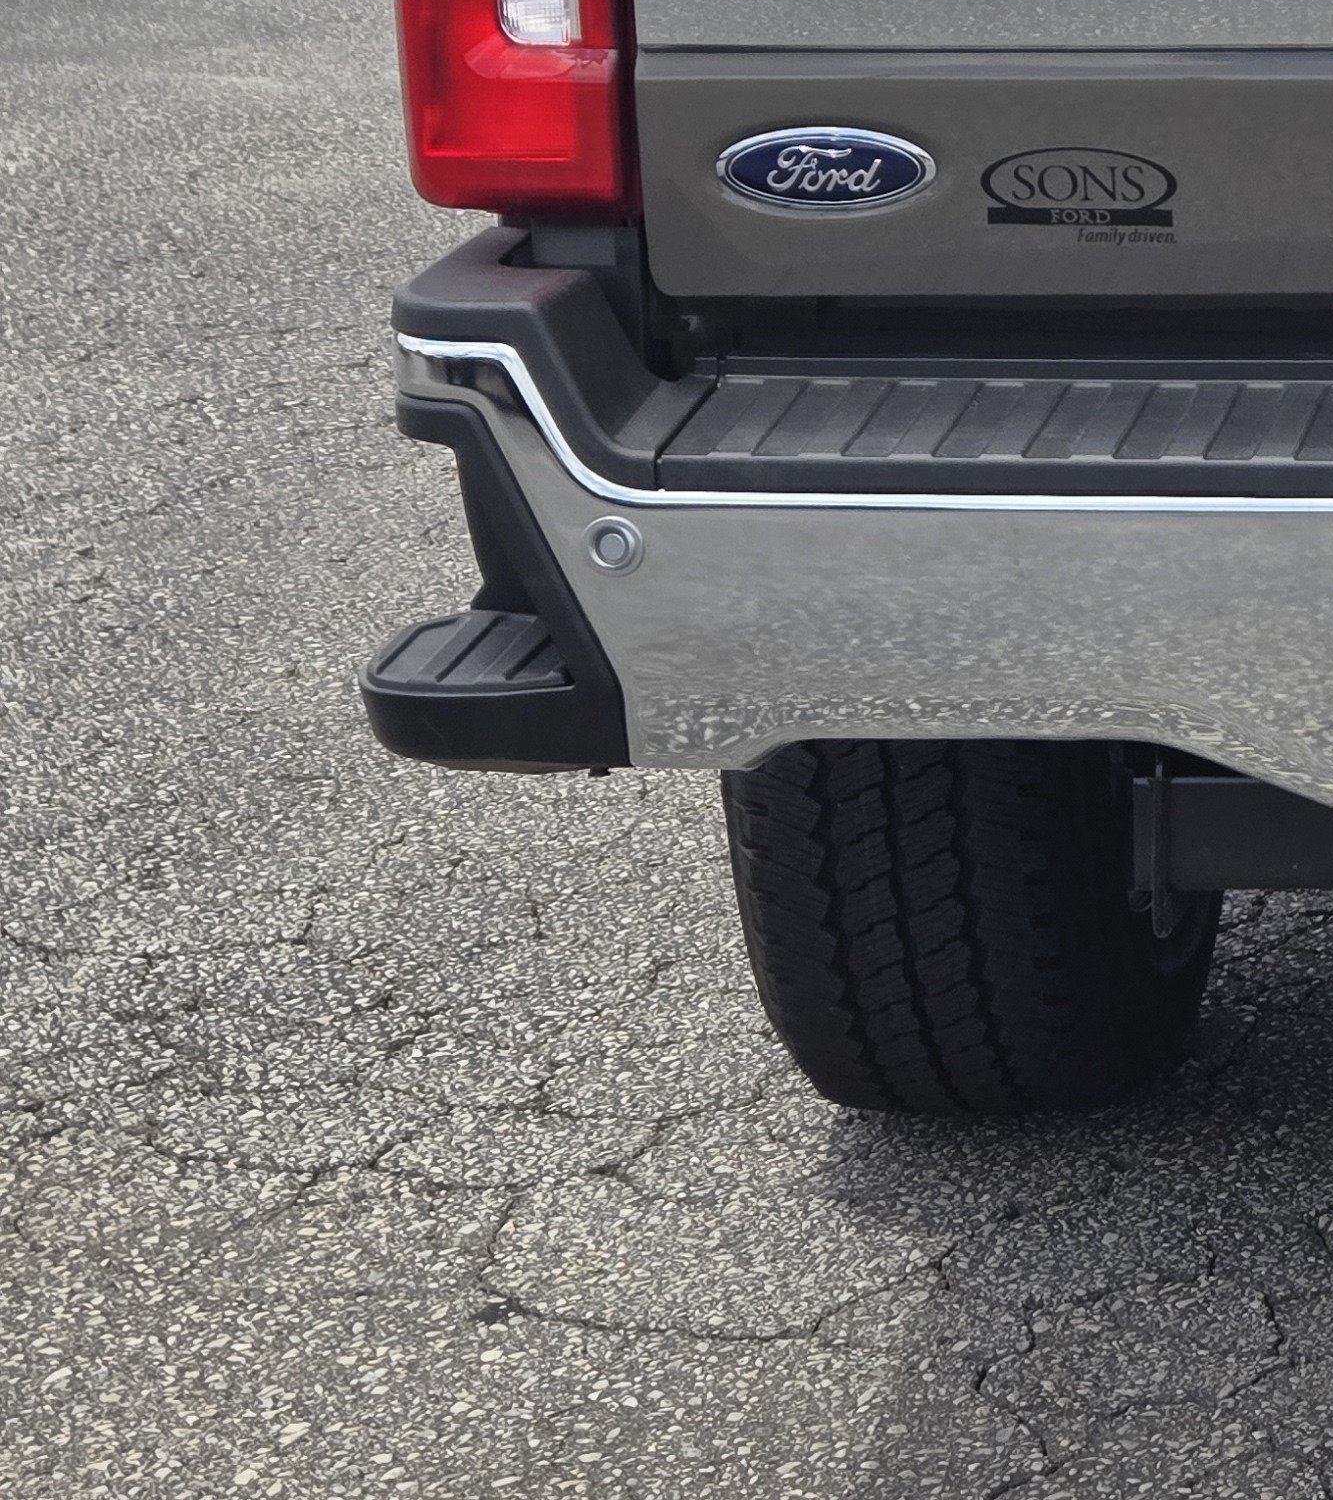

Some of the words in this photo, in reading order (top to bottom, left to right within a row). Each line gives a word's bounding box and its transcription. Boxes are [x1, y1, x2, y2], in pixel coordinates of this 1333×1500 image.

[765, 143, 883, 193] Ford
[1010, 163, 1148, 203] SONS
[1050, 208, 1112, 225] FORD
[1077, 227, 1126, 247] Family
